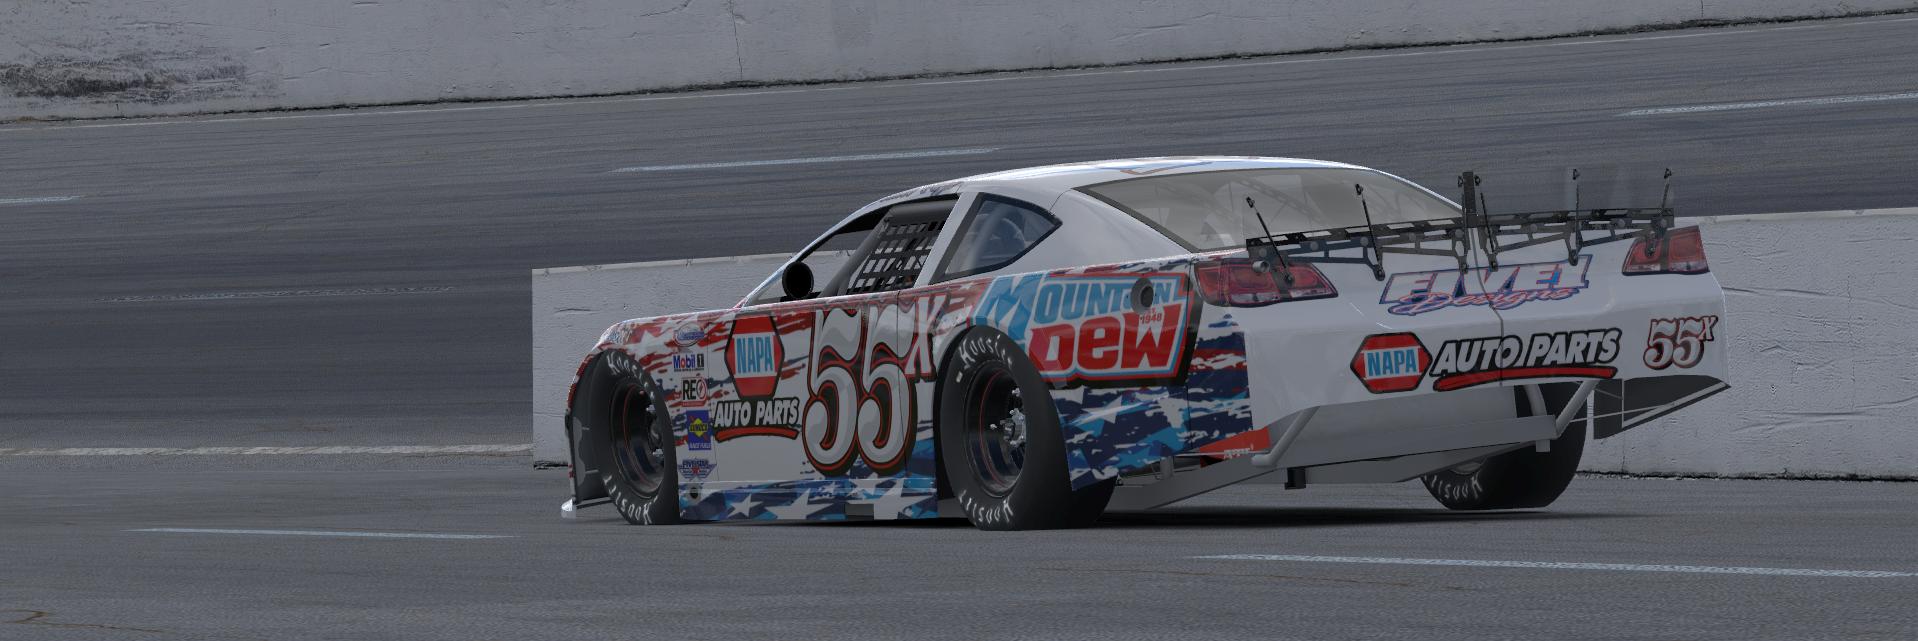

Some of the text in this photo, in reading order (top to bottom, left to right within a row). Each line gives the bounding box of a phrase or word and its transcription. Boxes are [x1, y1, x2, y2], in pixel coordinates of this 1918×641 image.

[974, 275, 1174, 342] MOUNTN
[673, 353, 696, 369] Mobil
[736, 336, 774, 374] NAPA
[1367, 347, 1418, 377] NAPA
[1431, 328, 1621, 377] AUTO PARTS
[714, 398, 799, 428] AUTO PARTS
